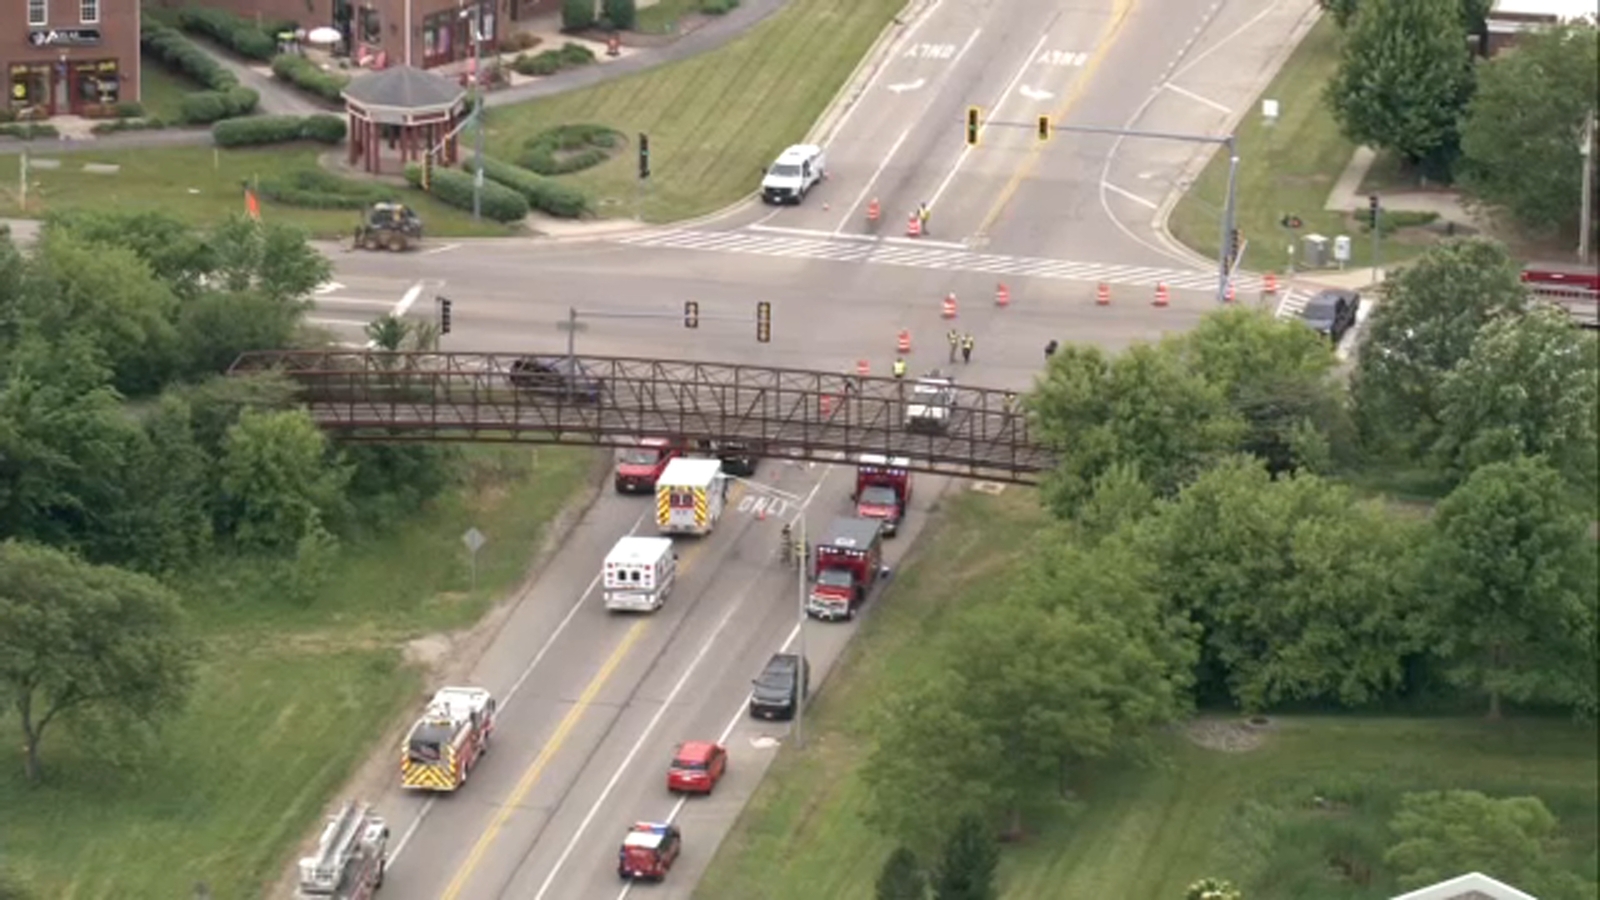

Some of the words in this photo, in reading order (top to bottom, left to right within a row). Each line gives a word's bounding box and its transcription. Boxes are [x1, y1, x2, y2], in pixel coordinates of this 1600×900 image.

[903, 43, 956, 59] ONLY
[1037, 50, 1088, 66] ONLY
[738, 495, 790, 517] ONLY
